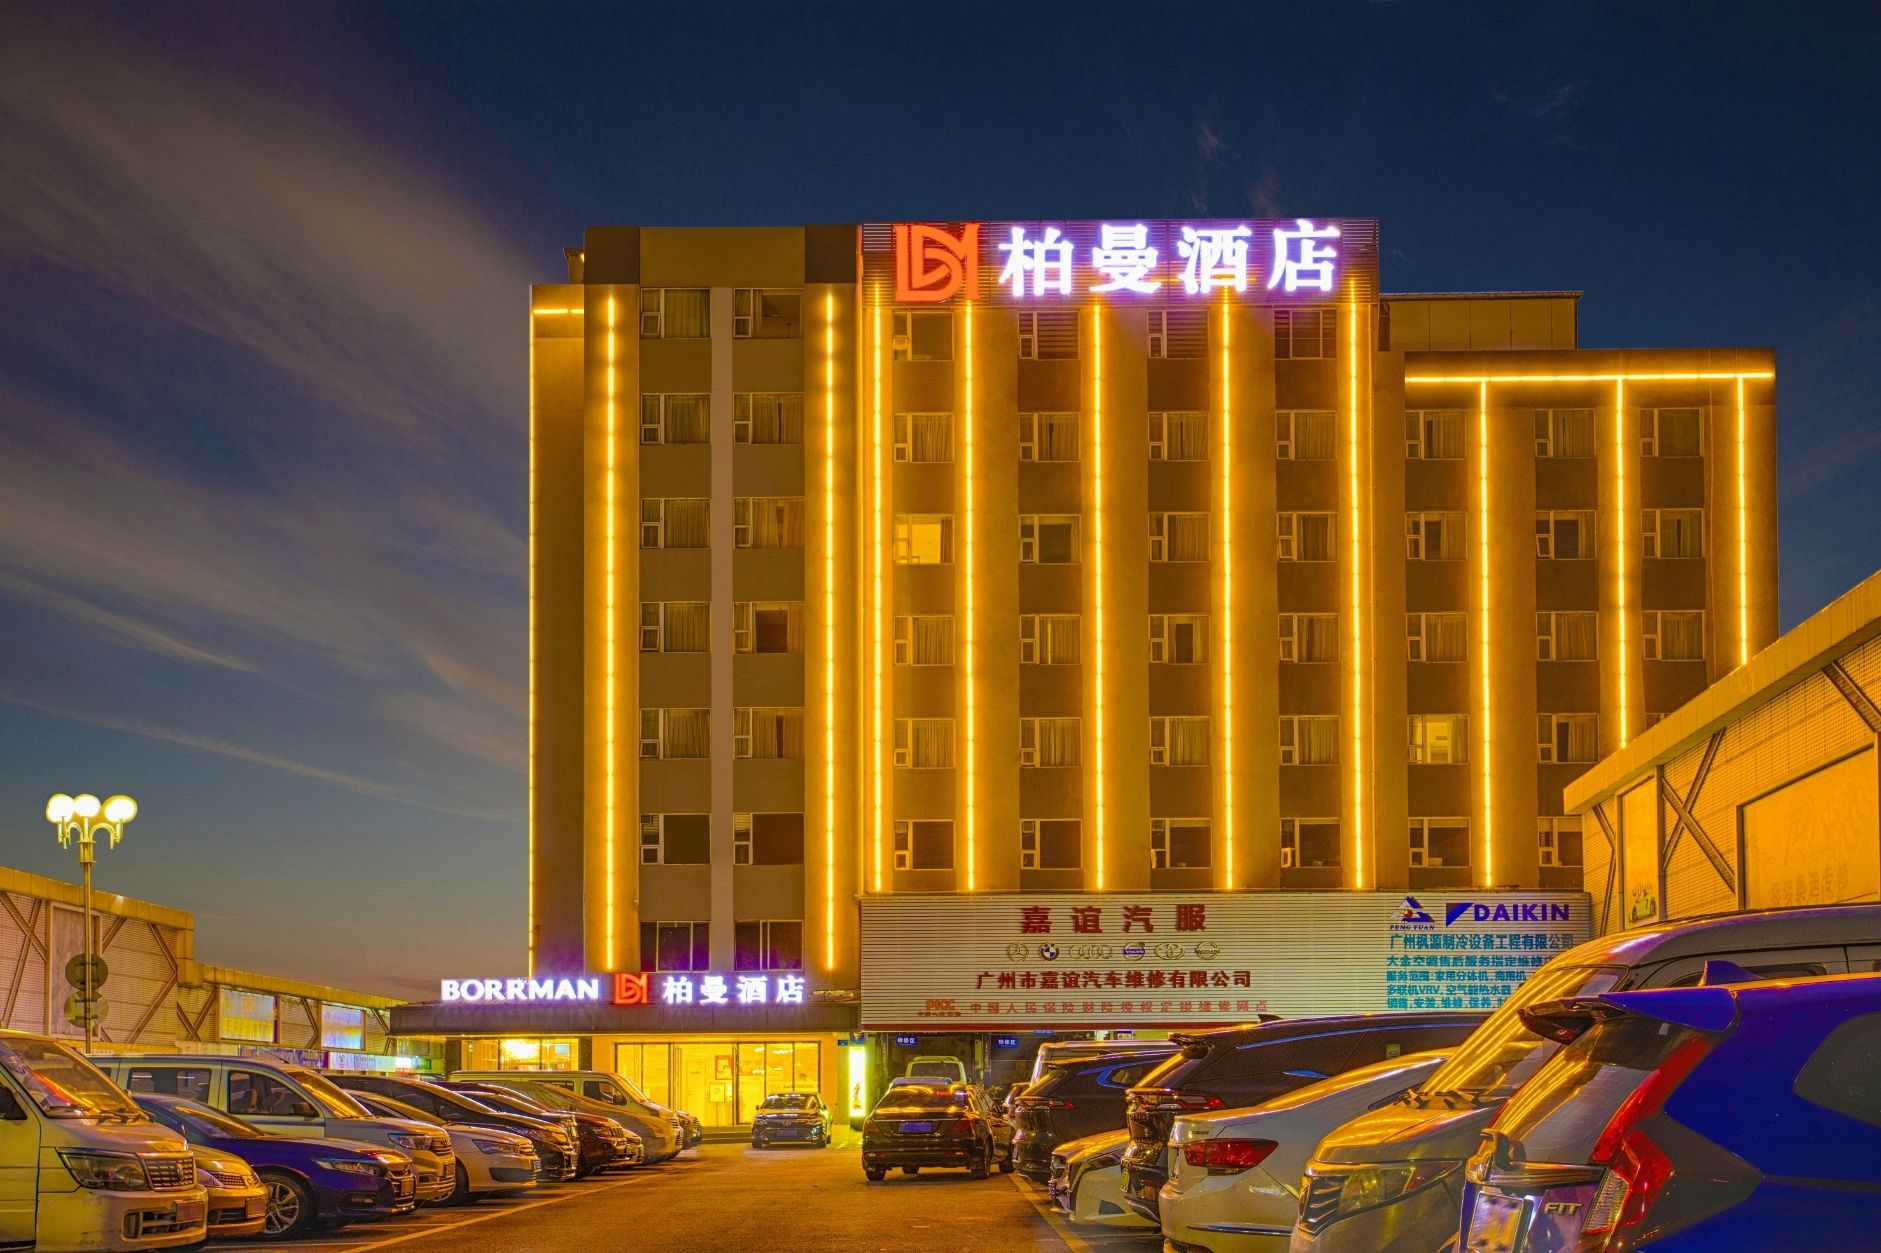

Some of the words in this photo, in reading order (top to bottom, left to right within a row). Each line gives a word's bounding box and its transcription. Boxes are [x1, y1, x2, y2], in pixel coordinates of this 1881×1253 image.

[998, 219, 1341, 296] 柏曼酒店
[1021, 904, 1206, 934] 嘉谊汽服
[1474, 903, 1570, 921] DAIKIN
[1391, 934, 1573, 950] 广州枫源制冷设备工程有限公司
[976, 970, 1251, 989] 广州市嘉谊汽车维修有限公司
[441, 978, 600, 1001] BORRMAN
[663, 975, 805, 1004] 柏曼酒店
[1544, 1202, 1583, 1215] FIT
